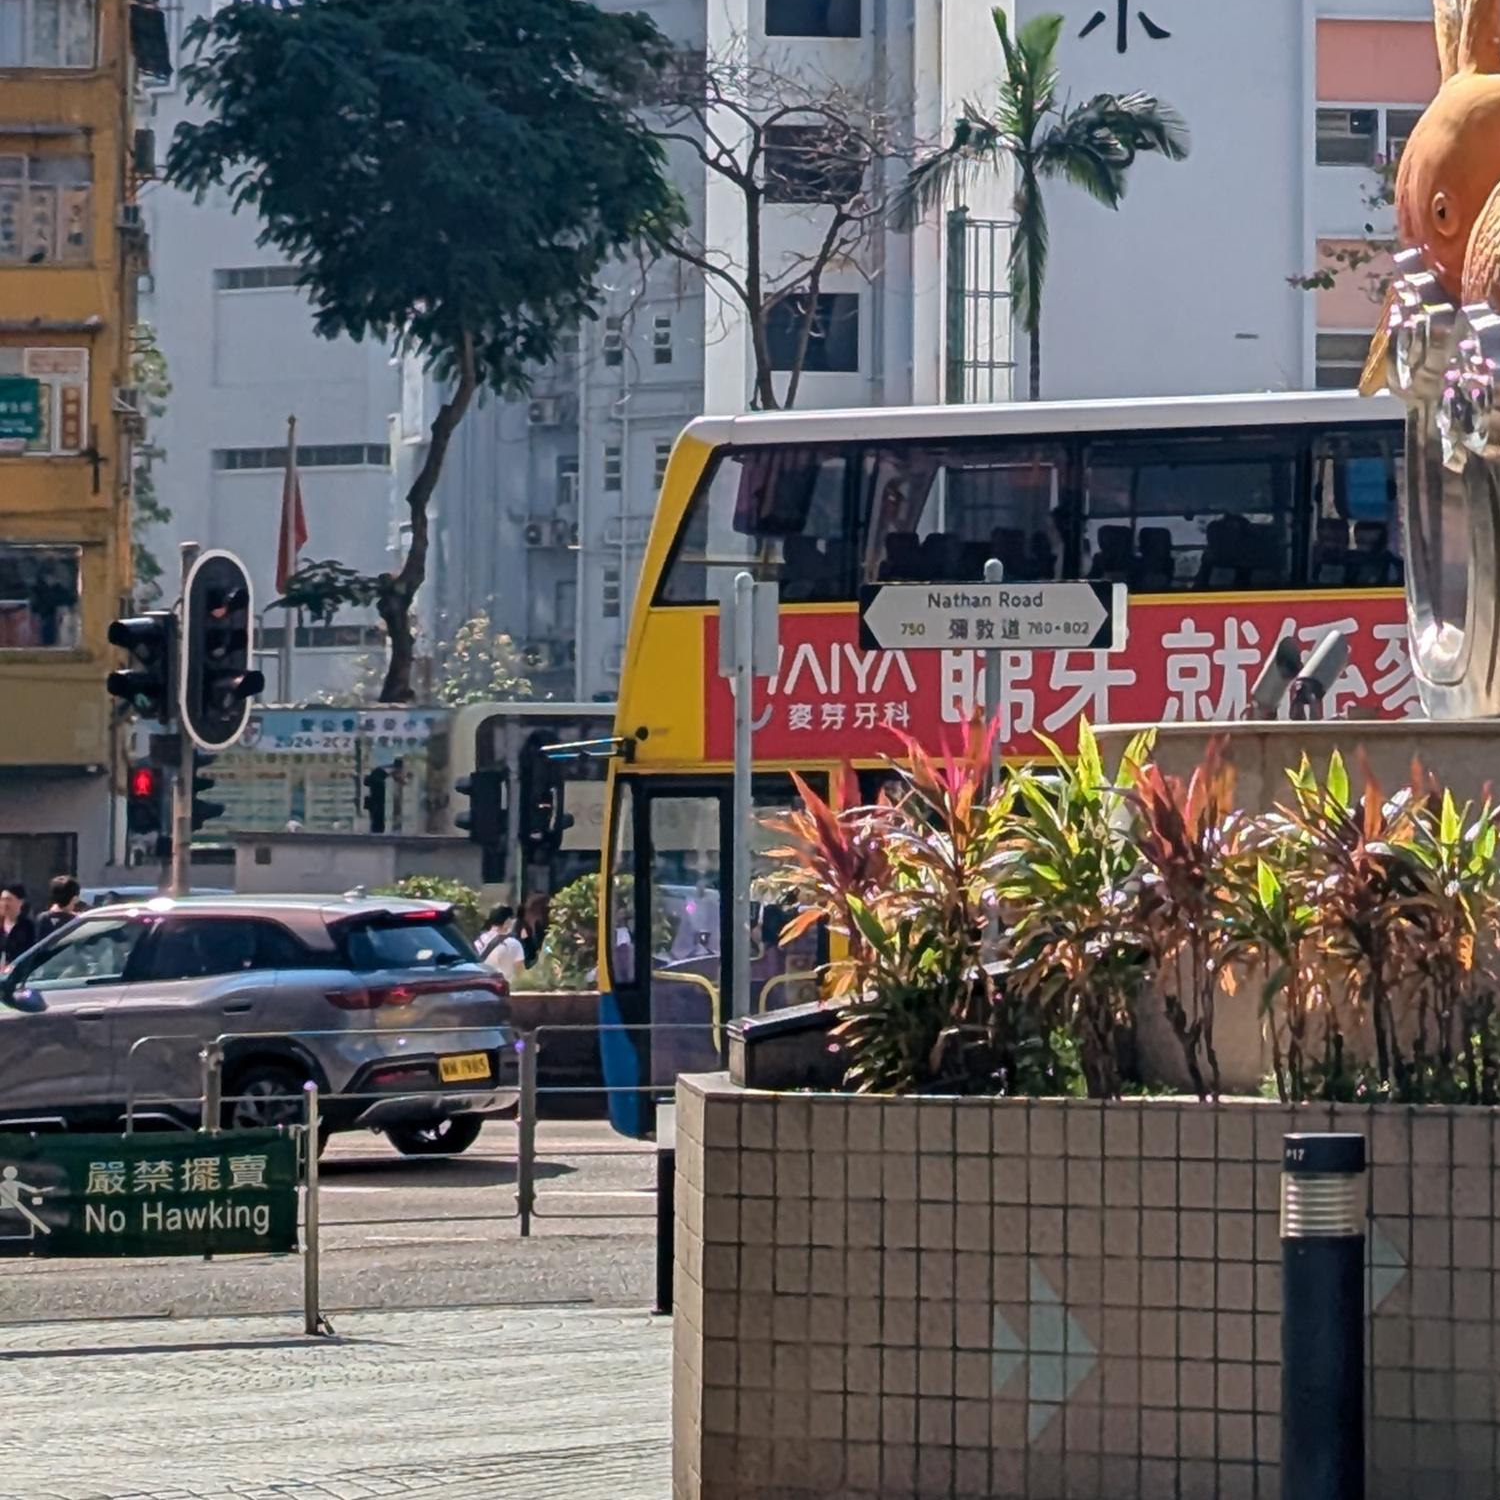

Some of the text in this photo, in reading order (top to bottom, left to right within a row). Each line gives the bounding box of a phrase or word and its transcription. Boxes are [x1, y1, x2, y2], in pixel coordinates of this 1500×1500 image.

[927, 591, 1044, 608] Nathan Road
[901, 622, 926, 636] 750
[949, 618, 1020, 640] 彌敦道
[788, 700, 911, 731] 麥芽牙科
[85, 1155, 269, 1195] 嚴禁擺賣
[85, 1199, 270, 1236] No Hawking
